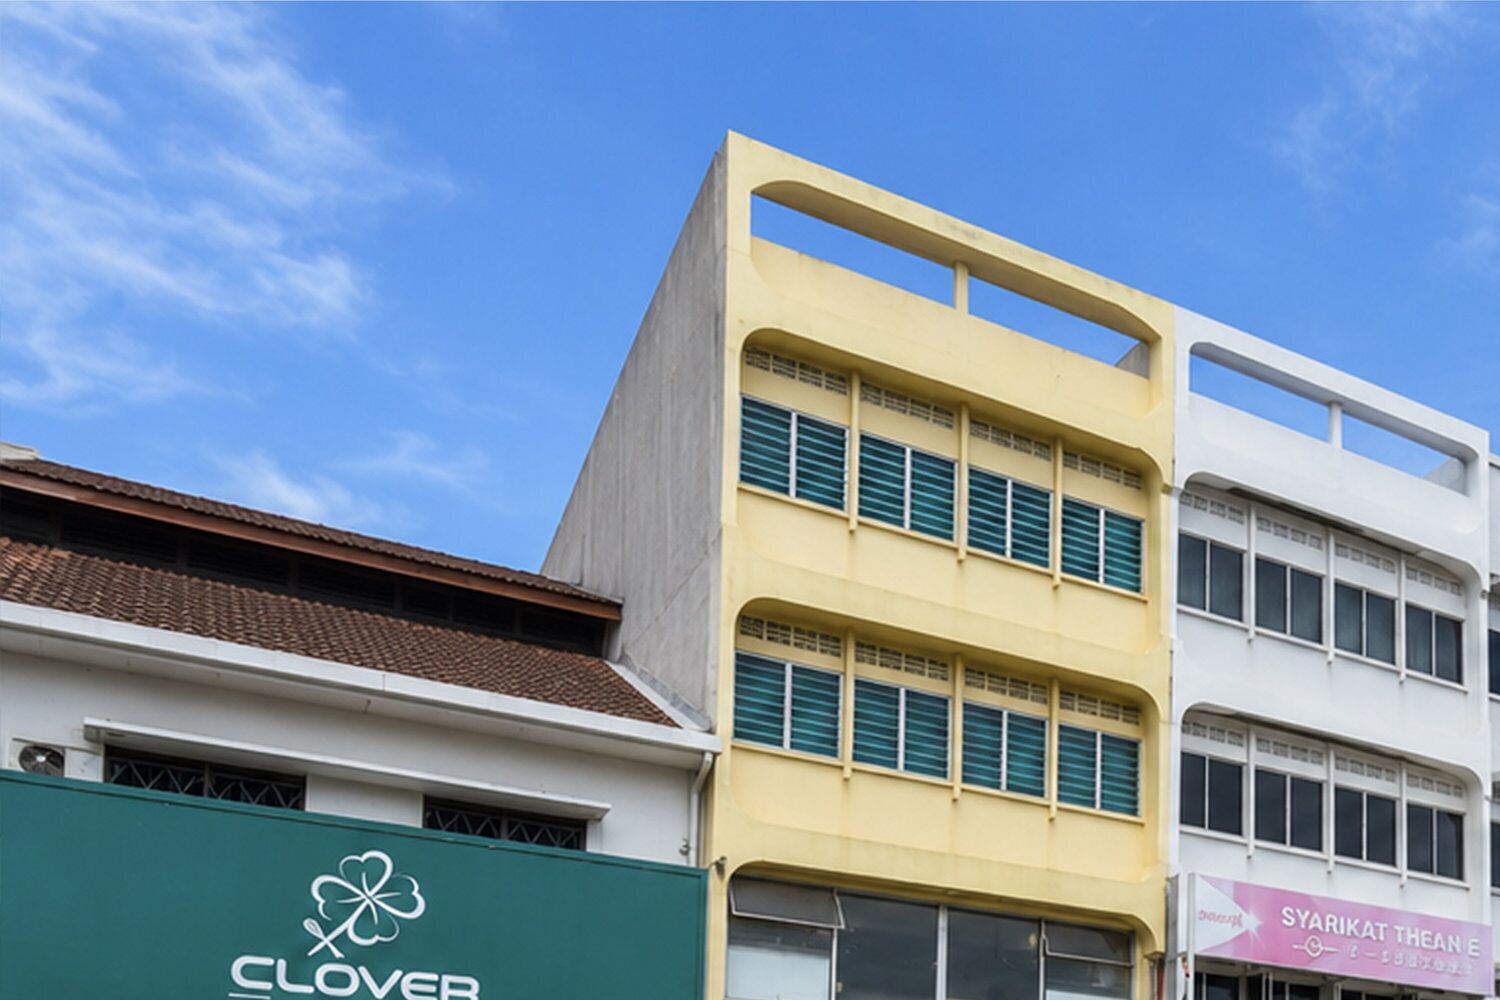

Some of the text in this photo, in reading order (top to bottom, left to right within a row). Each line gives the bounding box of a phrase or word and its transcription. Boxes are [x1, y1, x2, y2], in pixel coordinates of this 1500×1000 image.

[1281, 906, 1480, 957] SYARIKAT THEAN E
